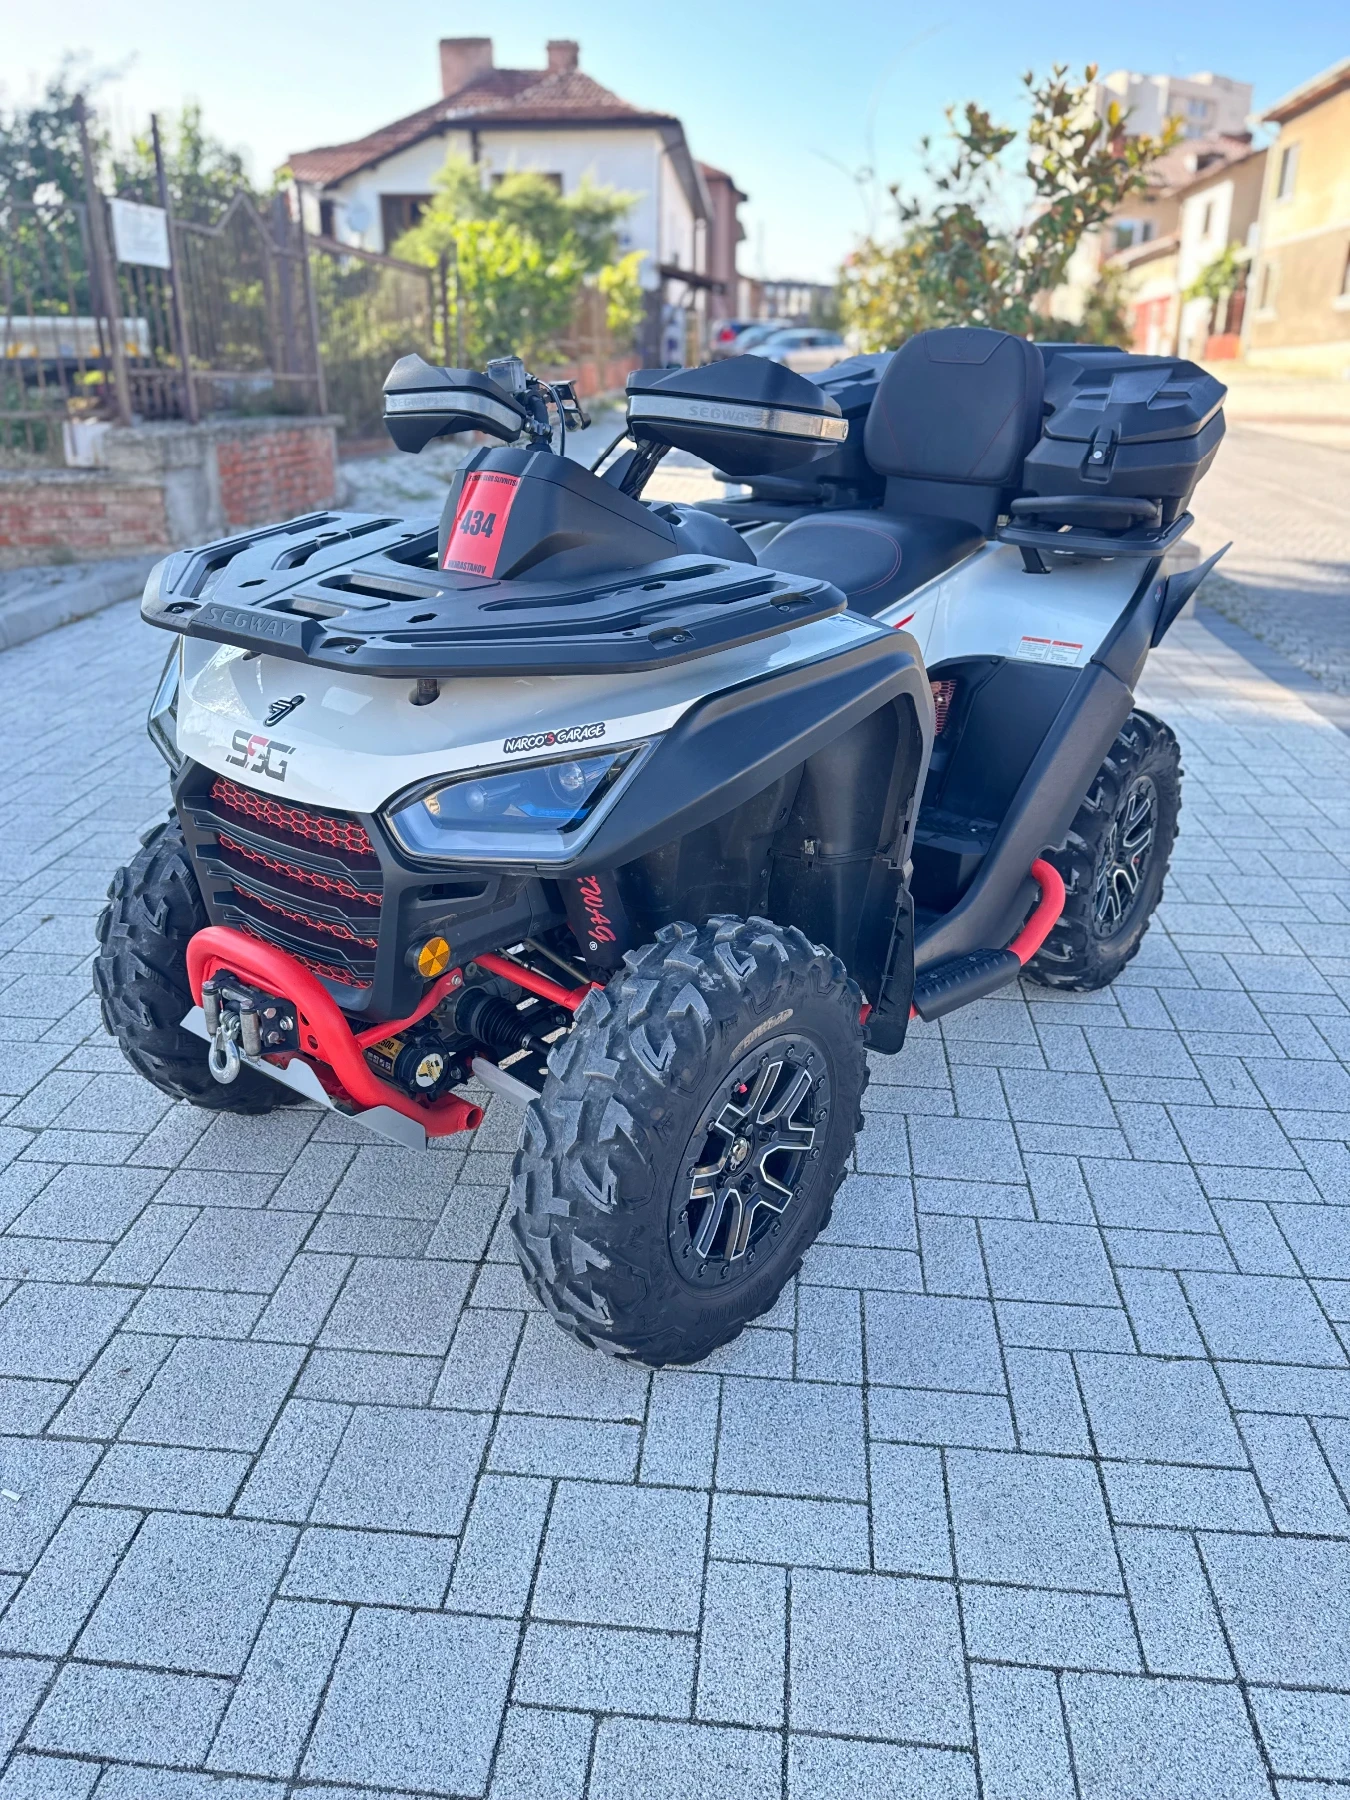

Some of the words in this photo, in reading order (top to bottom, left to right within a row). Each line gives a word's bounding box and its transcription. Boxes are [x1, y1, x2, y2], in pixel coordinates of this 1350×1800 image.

[460, 509, 497, 539] 434
[205, 607, 295, 638] SEGWAY
[503, 732, 556, 752] NARCO'S
[556, 722, 605, 743] GARAGE
